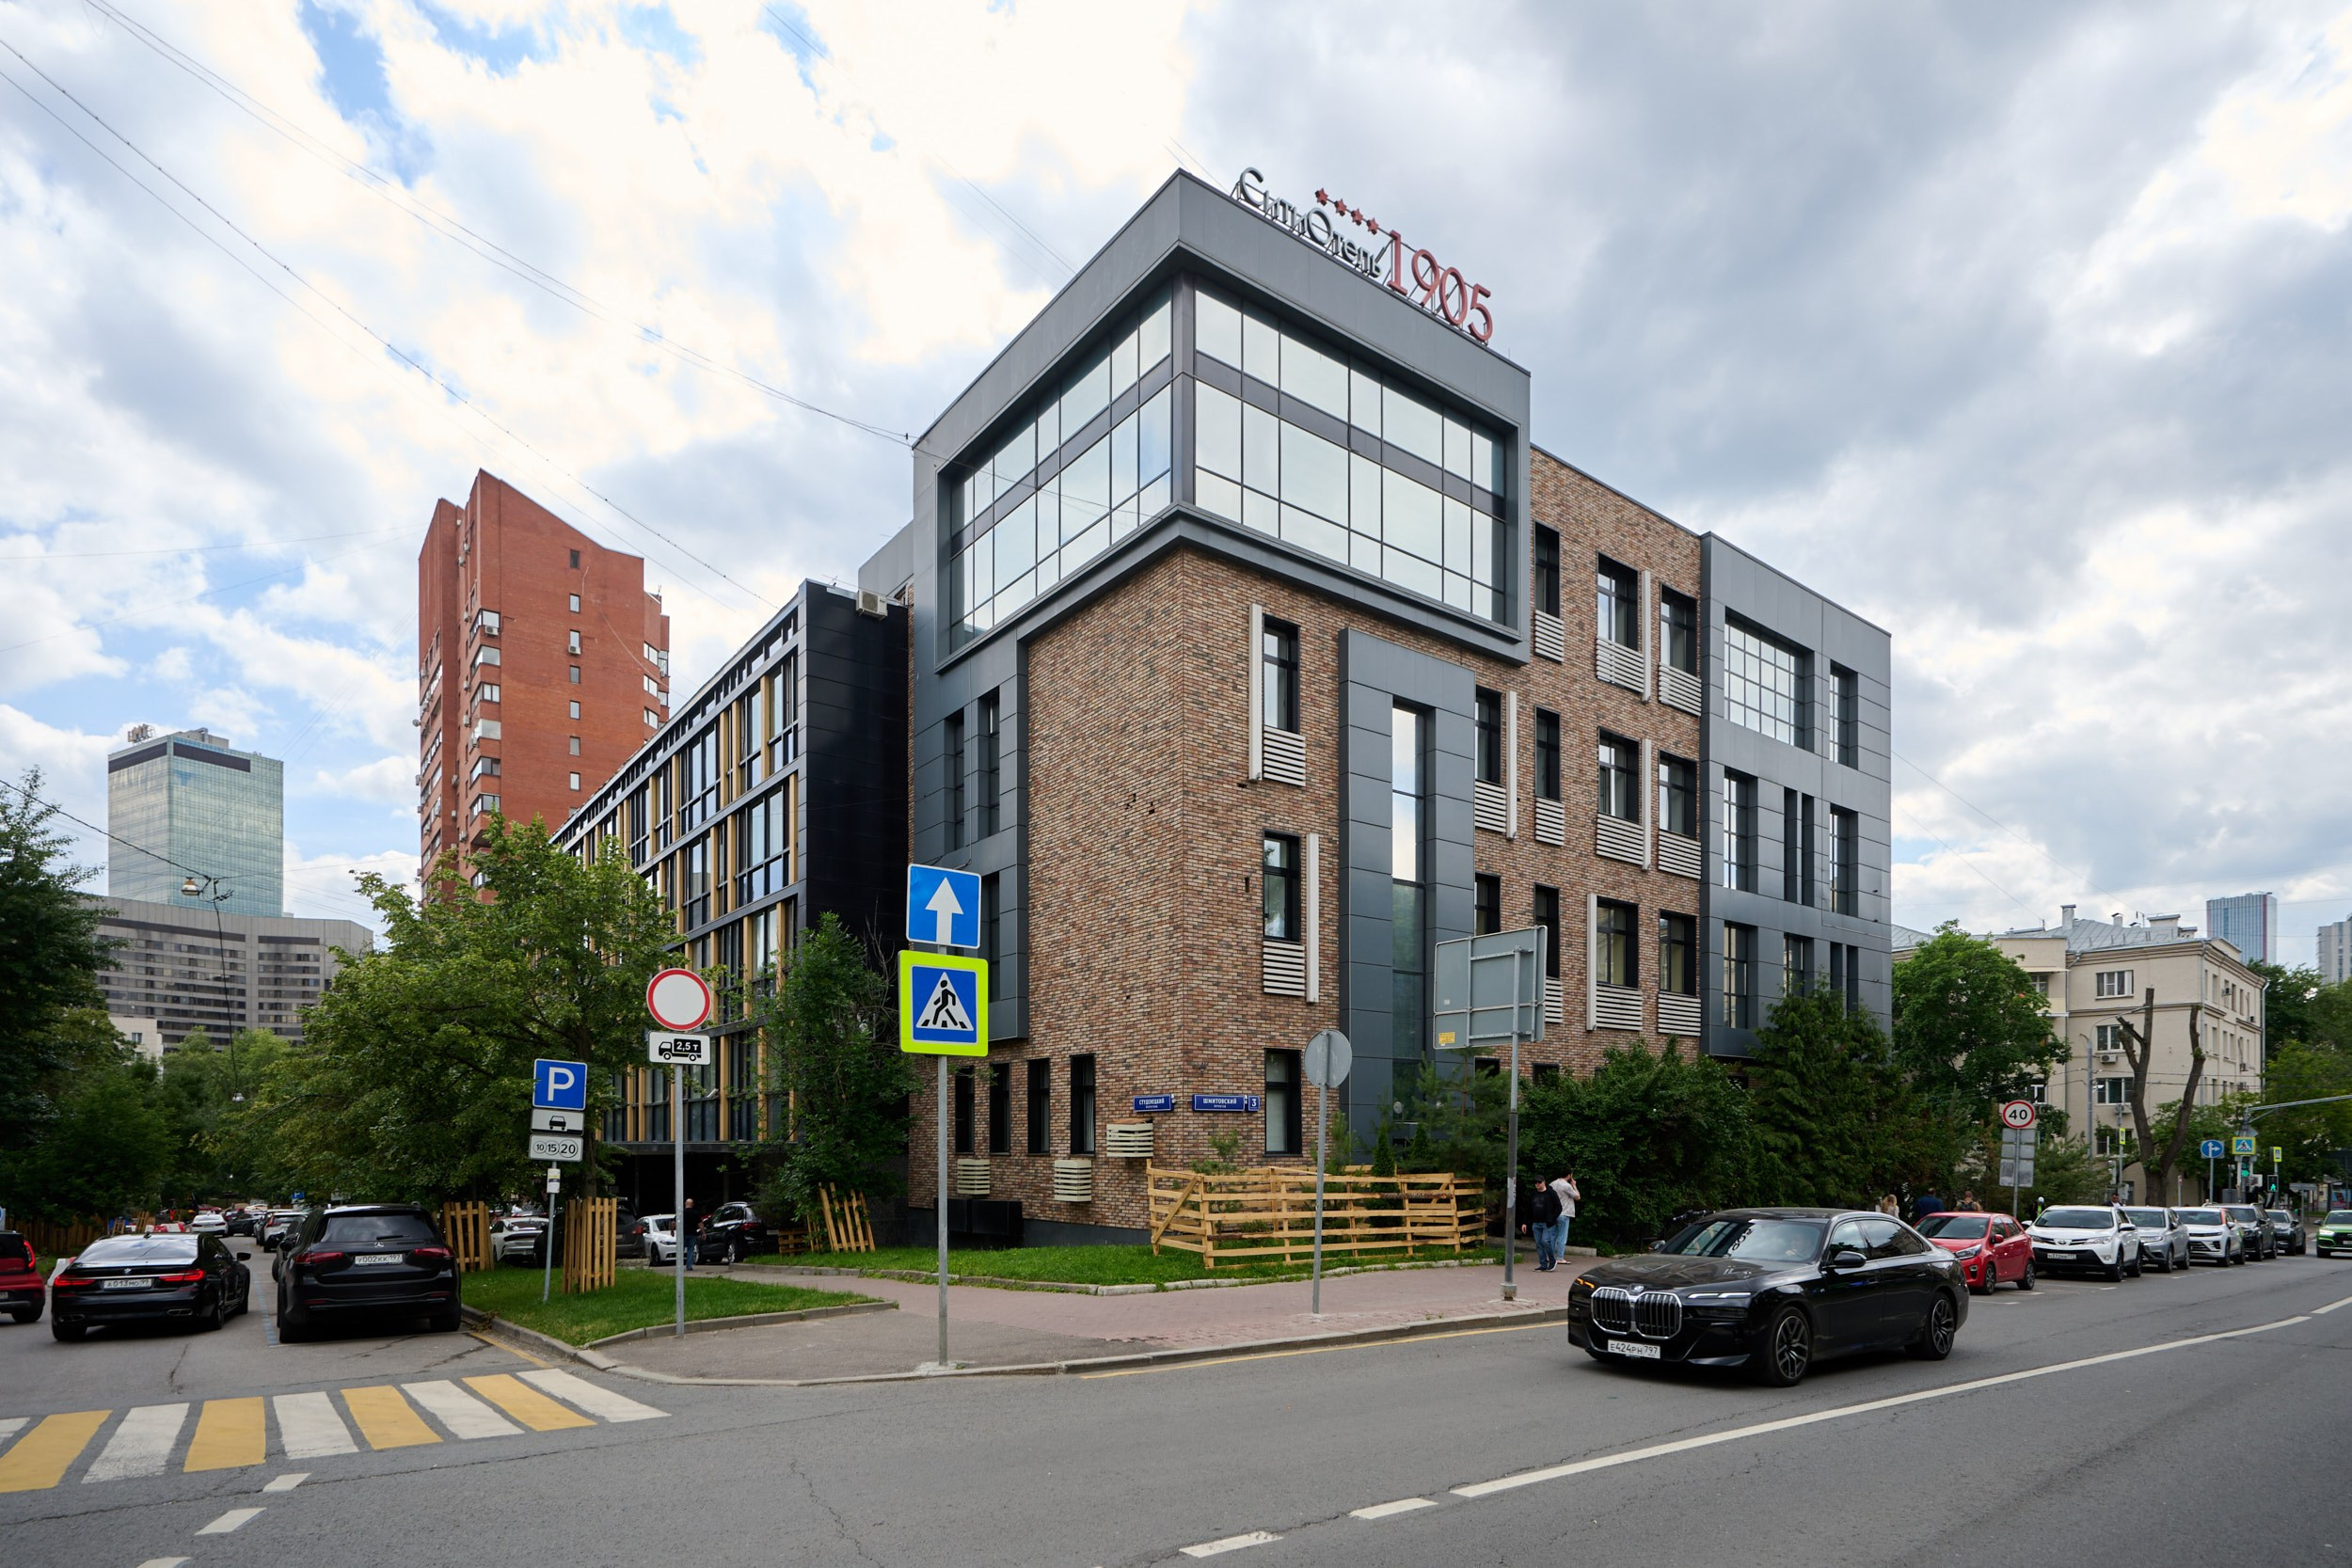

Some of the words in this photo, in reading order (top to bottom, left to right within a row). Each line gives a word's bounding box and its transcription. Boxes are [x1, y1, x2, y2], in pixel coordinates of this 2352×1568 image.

[1240, 167, 1383, 277] СитиОтель
[1387, 230, 1493, 342] 1905
[676, 1041, 691, 1052] 2,5
[548, 1067, 576, 1101] P
[1251, 1098, 1257, 1107] 3
[2008, 1109, 2028, 1120] 40
[548, 1143, 557, 1153] 15
[560, 1143, 576, 1154] 20
